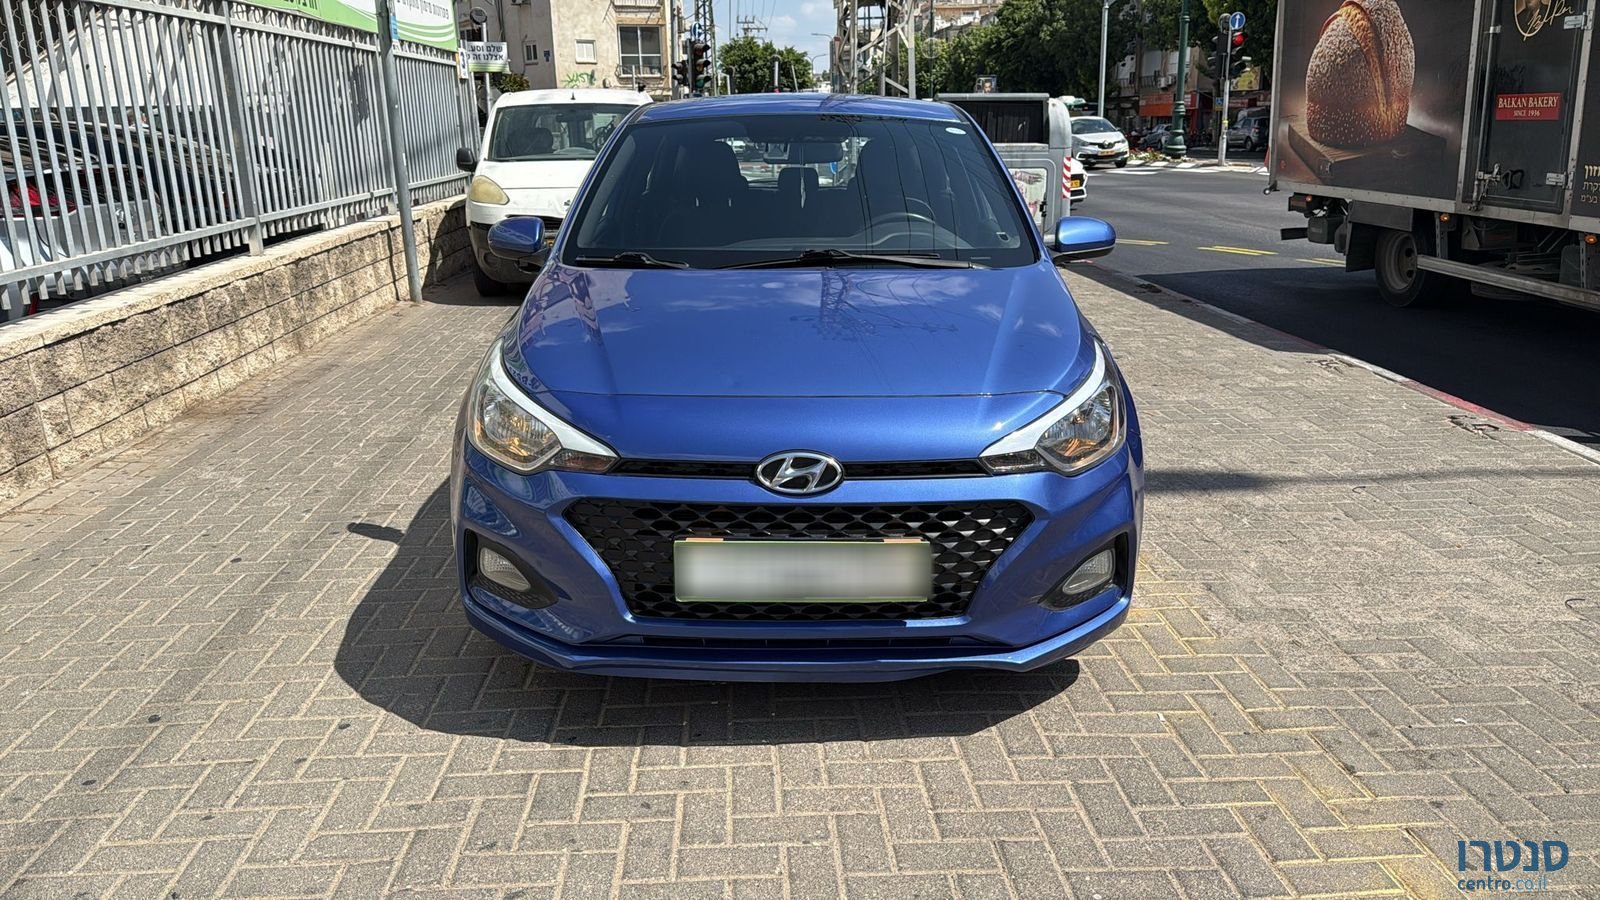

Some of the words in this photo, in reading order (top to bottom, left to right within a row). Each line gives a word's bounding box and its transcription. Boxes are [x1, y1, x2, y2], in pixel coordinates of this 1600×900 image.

[486, 44, 503, 52] שלם
[1498, 97, 1527, 108] BALKAN
[1528, 96, 1559, 108] BAKERY
